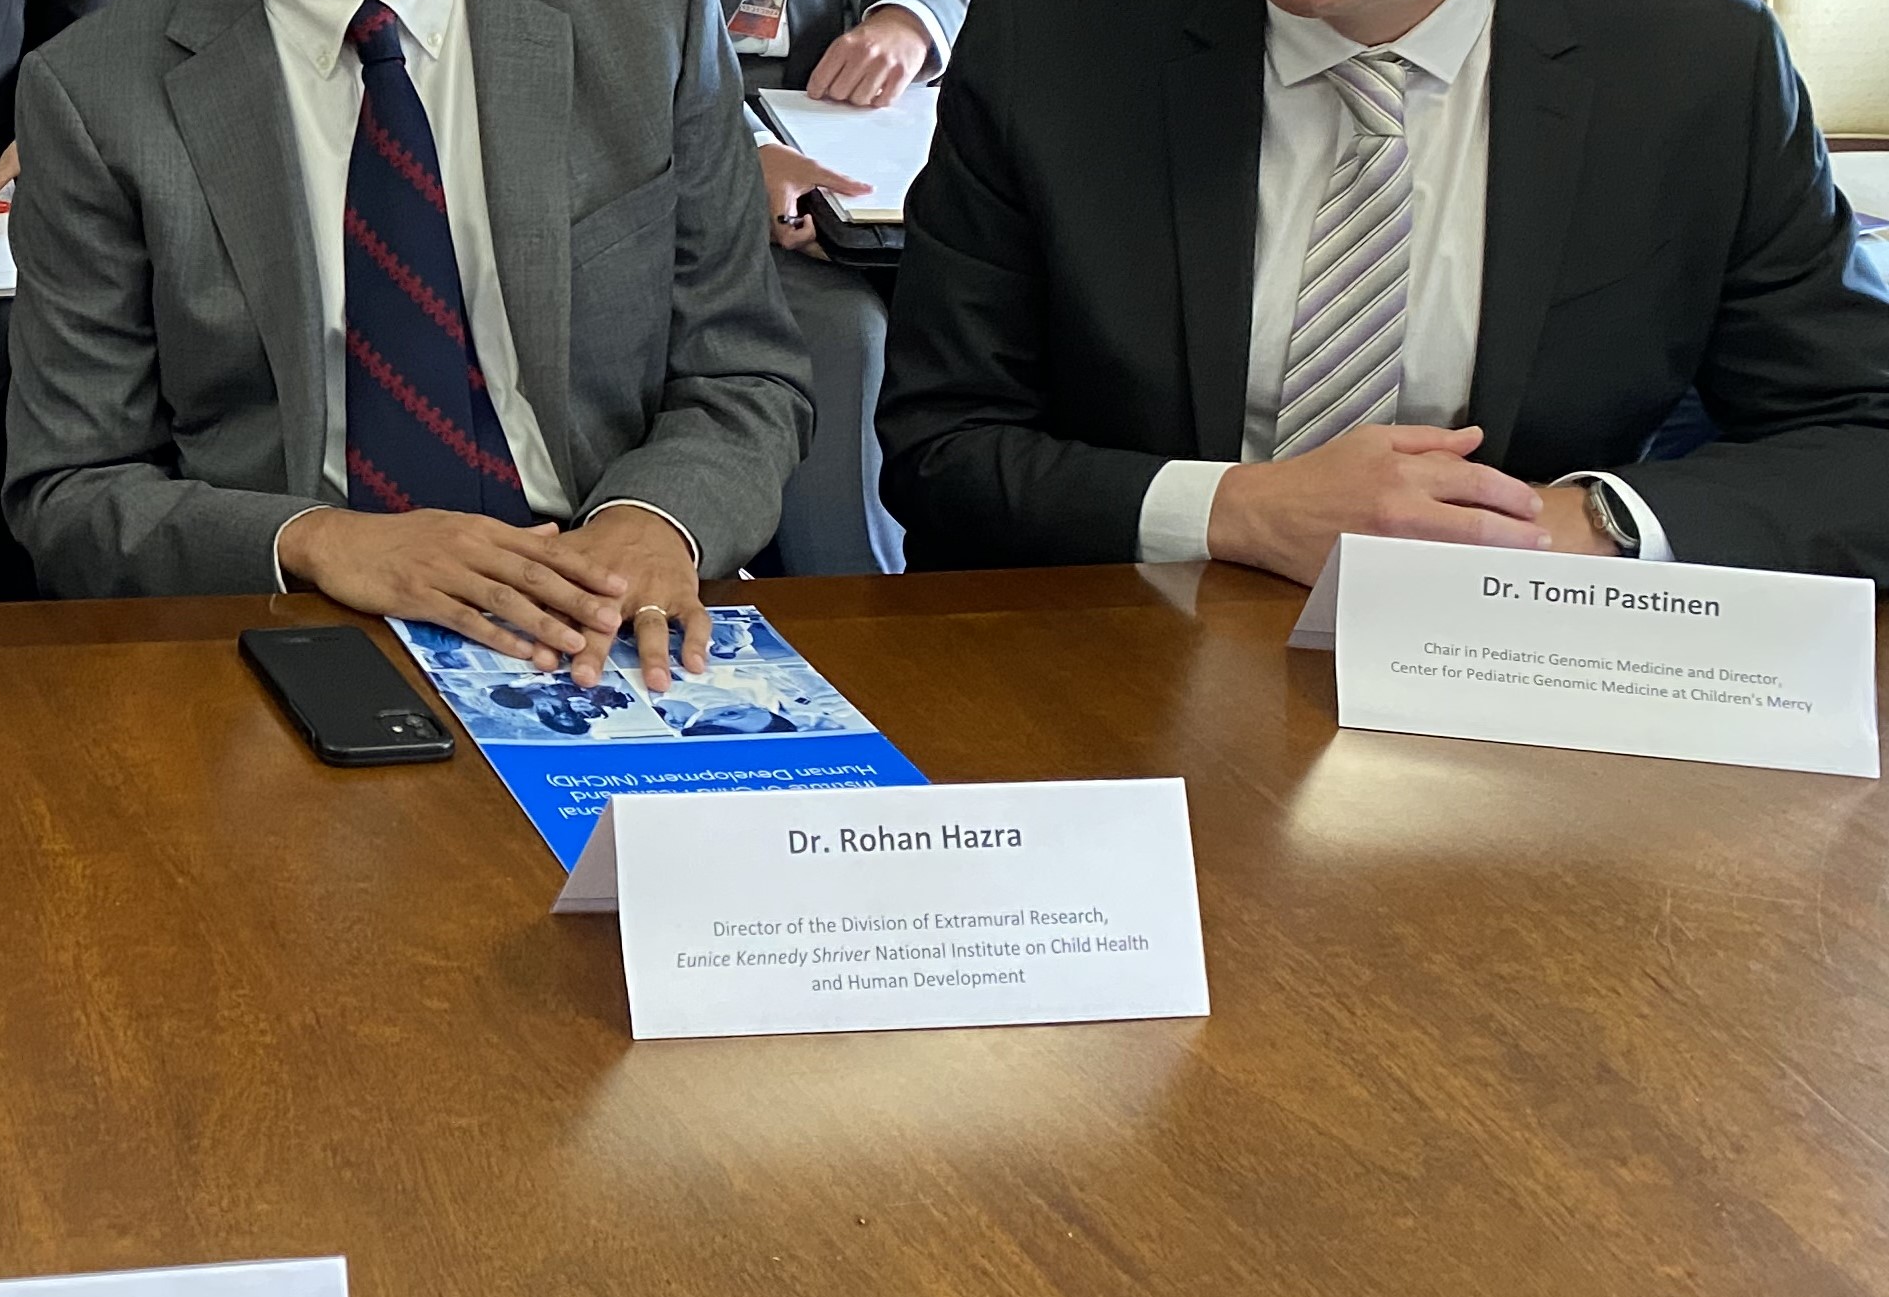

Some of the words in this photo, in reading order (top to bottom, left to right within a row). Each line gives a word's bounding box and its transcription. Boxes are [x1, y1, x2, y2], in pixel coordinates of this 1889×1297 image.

[1483, 576, 1520, 599] Dr.
[1528, 580, 1595, 606] Tomi
[1605, 587, 1720, 617] Pastinen
[1423, 642, 1462, 657] Chair
[1464, 645, 1478, 658] in
[1482, 647, 1545, 665] Pediatric
[1548, 653, 1613, 671] Genomic
[1616, 659, 1684, 677] Medicine
[1687, 667, 1715, 680] and
[1719, 668, 1782, 688] Director,
[1390, 660, 1439, 676] Center
[1441, 664, 1463, 679] for
[1466, 667, 1530, 685] Pediatric
[1532, 674, 1598, 691] Genomic
[1601, 680, 1669, 698] Medicine
[1671, 688, 1688, 700] at
[1766, 695, 1813, 714] Mercy
[545, 772, 639, 788] (NICHD)
[640, 769, 794, 784] Development
[794, 764, 878, 778] Human
[568, 789, 613, 804] and
[557, 805, 607, 820] onal
[788, 830, 830, 855] Dr.
[840, 824, 932, 853] Rohan
[941, 824, 1022, 850] Hazra
[713, 920, 782, 937] Director
[786, 917, 804, 935] of
[808, 916, 837, 934] the
[841, 915, 908, 933] Division
[912, 912, 930, 930] of
[934, 909, 1025, 929] Extramural
[1029, 906, 1109, 925] Research,
[676, 951, 731, 969] Eunice
[736, 947, 809, 968] Kennedy
[812, 946, 871, 964] Shriver
[875, 942, 946, 961] National
[951, 941, 1021, 958] Institute
[1025, 942, 1046, 956] on
[1050, 936, 1092, 955] Child
[1095, 934, 1149, 952] Health
[811, 974, 843, 992] and
[847, 974, 909, 990] Human
[913, 968, 1026, 989] Development
